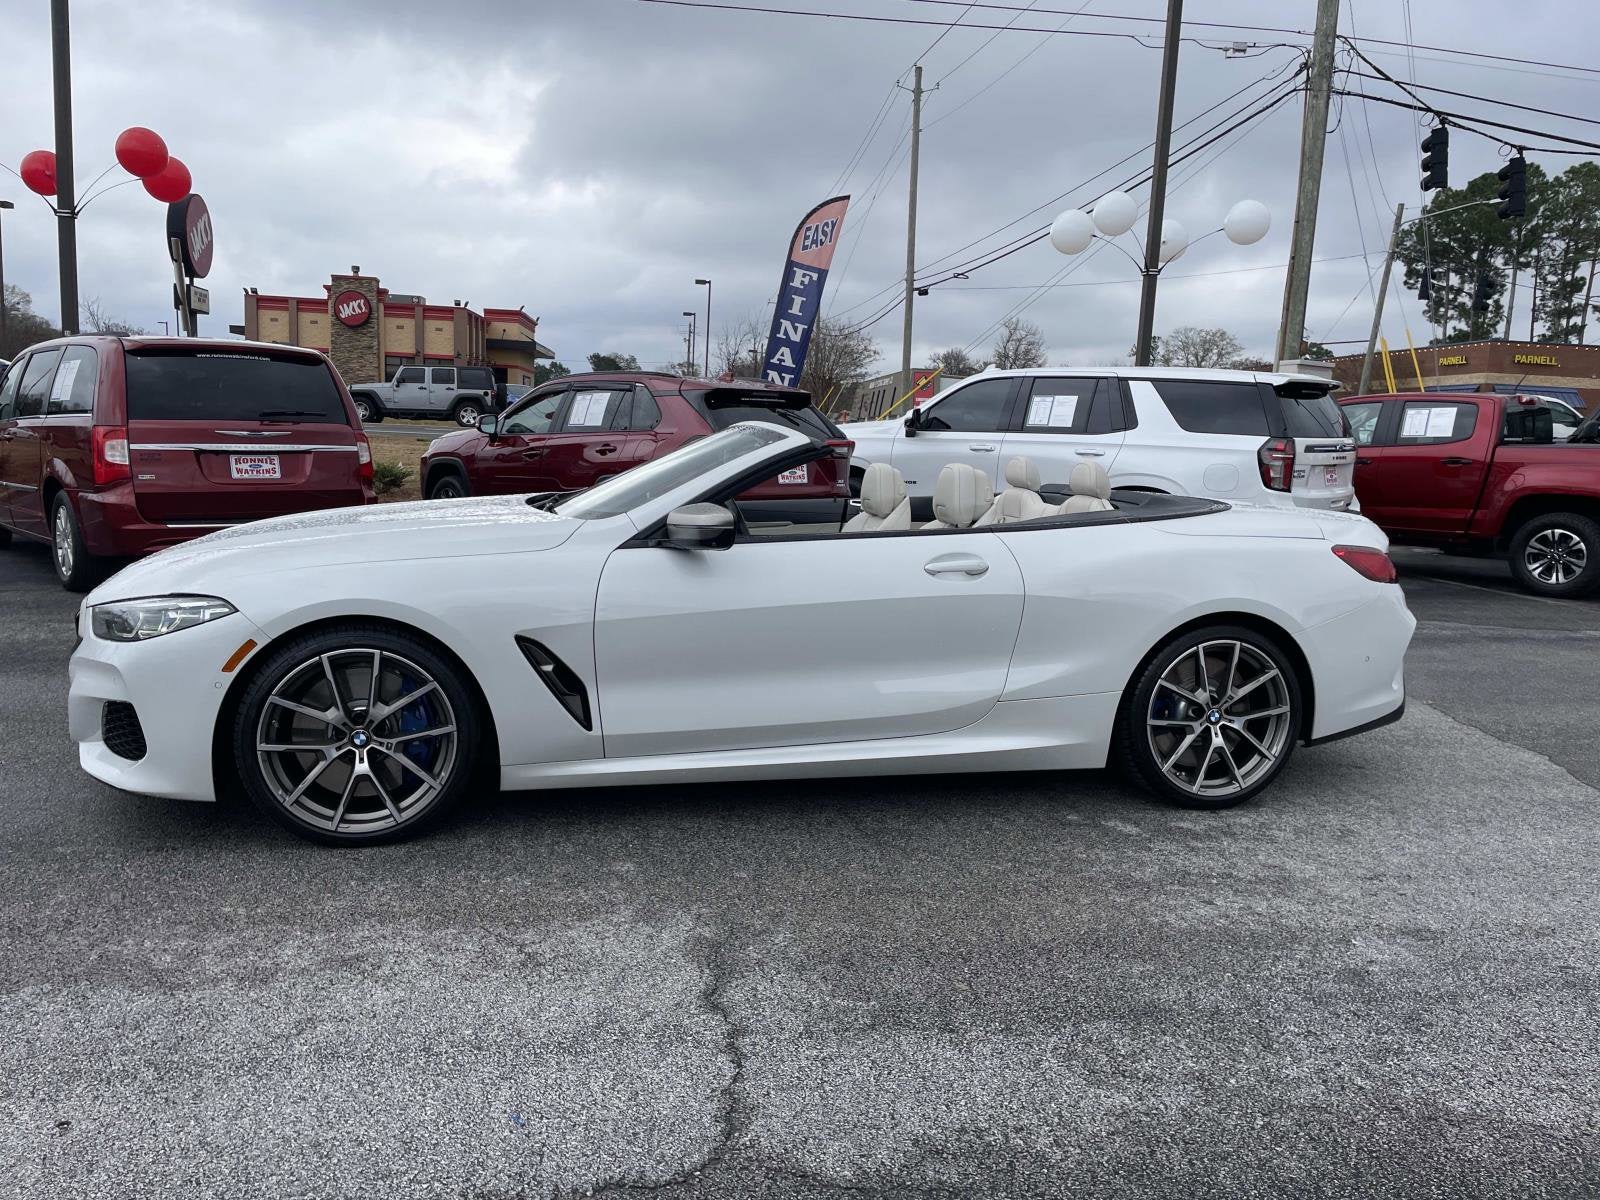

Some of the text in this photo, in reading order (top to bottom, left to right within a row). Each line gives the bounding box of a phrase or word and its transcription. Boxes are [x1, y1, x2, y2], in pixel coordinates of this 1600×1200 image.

[801, 217, 839, 252] EASY
[1439, 355, 1467, 366] PARNELL
[1514, 354, 1559, 366] PARNELL
[234, 457, 276, 466] RONNIE
[235, 466, 277, 475] WATKINS
[780, 473, 806, 481] WATKINS
